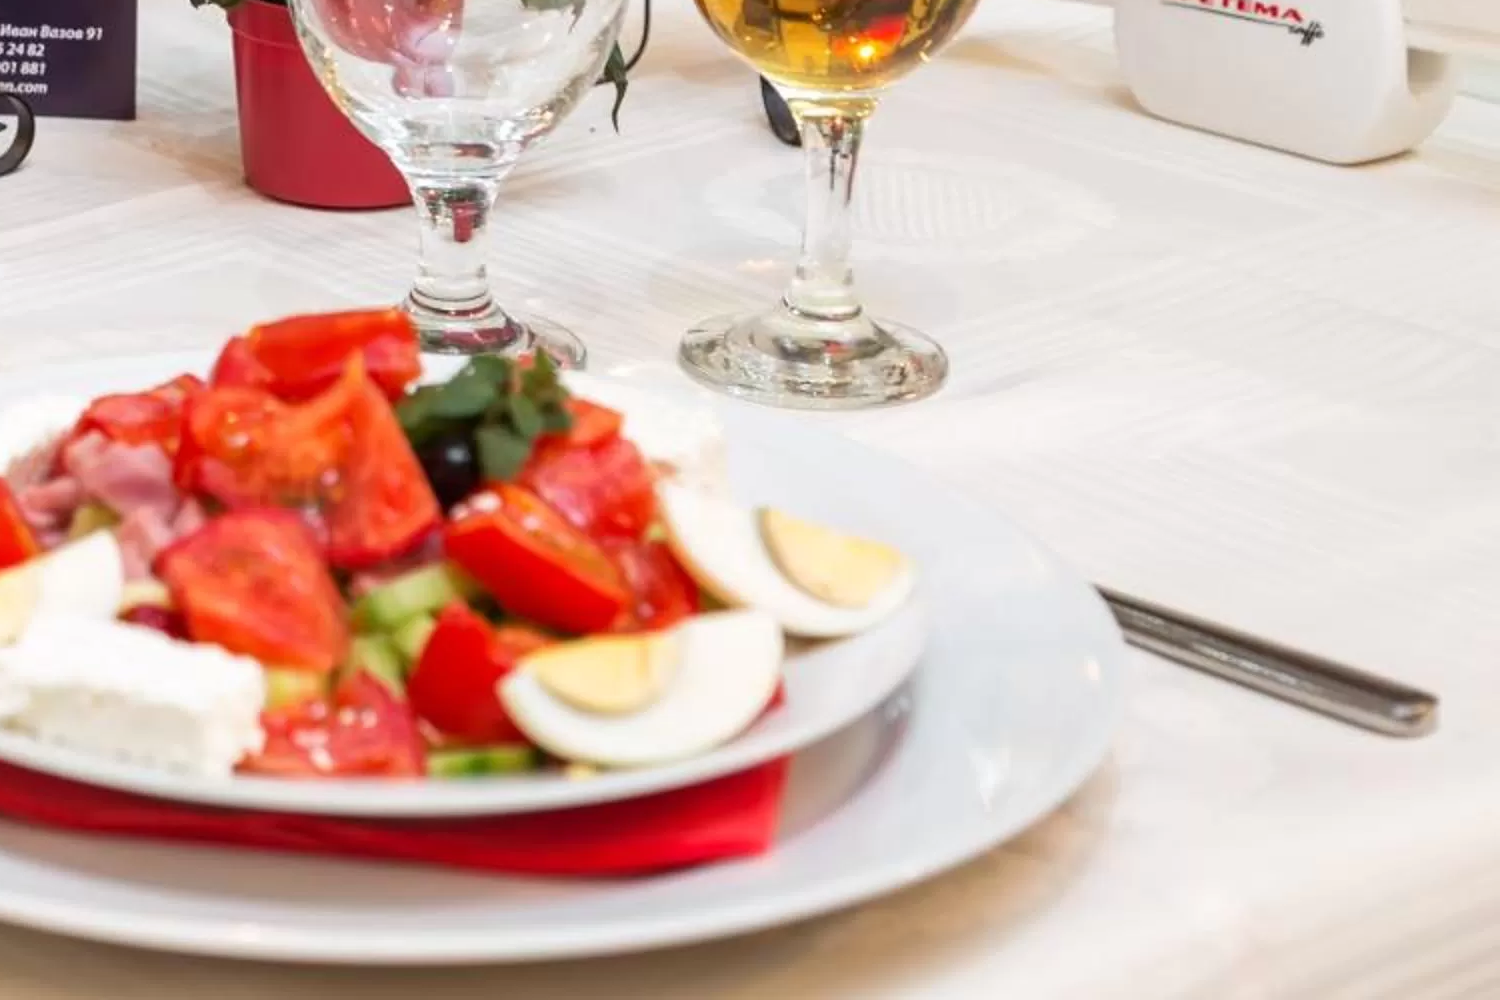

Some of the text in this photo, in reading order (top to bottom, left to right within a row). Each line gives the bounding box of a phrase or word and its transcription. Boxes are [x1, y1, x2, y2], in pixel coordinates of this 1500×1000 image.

[86, 27, 103, 40] 91
[6, 43, 25, 57] 24
[27, 43, 45, 57] 82
